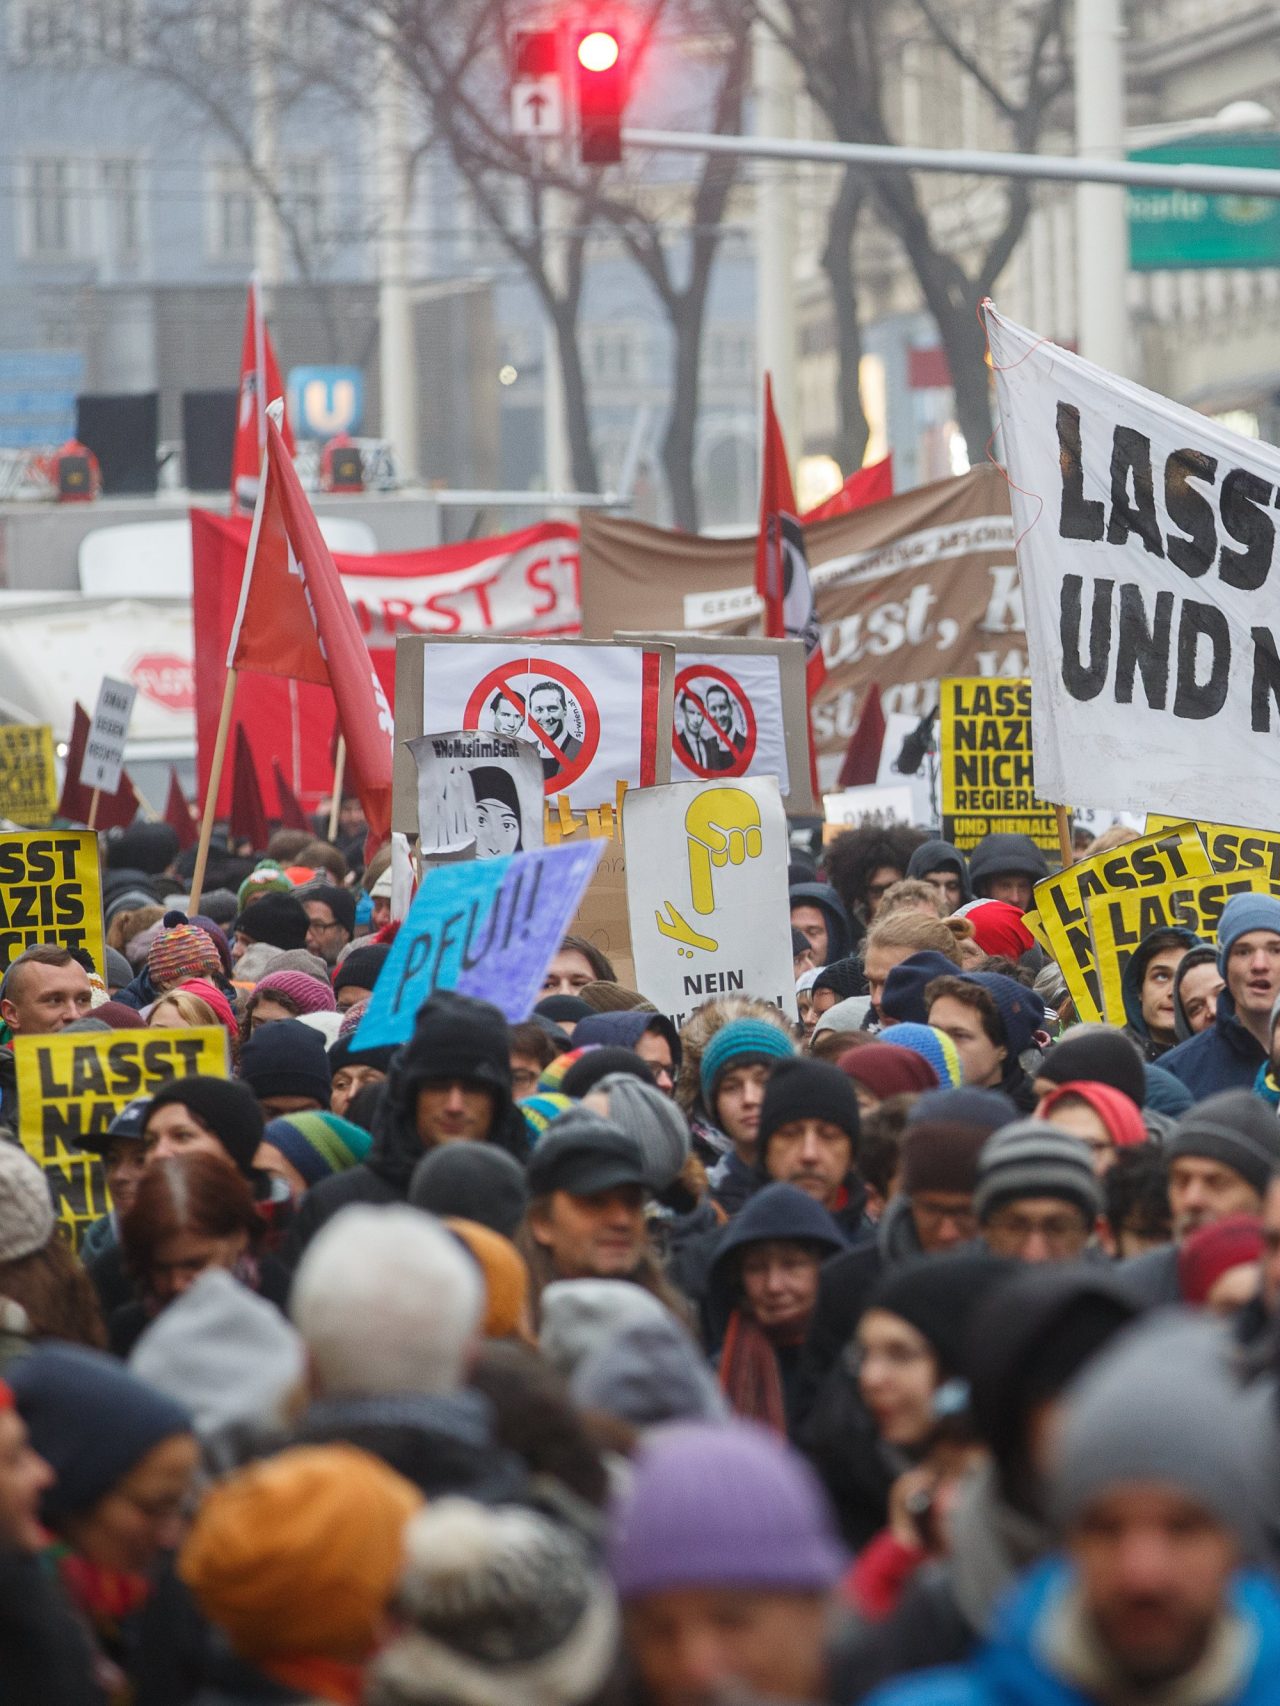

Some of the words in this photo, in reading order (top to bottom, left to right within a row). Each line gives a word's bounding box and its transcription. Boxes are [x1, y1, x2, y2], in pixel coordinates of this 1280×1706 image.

[304, 379, 356, 433] U
[819, 583, 960, 671] ust,
[976, 564, 1027, 634] K
[1061, 573, 1231, 720] UND
[953, 685, 1032, 717] LASS
[953, 720, 1033, 751] NAZI
[954, 755, 1035, 787] NICH
[954, 818, 987, 836] UND
[0, 839, 81, 884] SST
[1050, 833, 1189, 926] LASST
[0, 882, 85, 928] ZIS
[683, 968, 744, 996] NEIN
[36, 1038, 205, 1099] LASST
